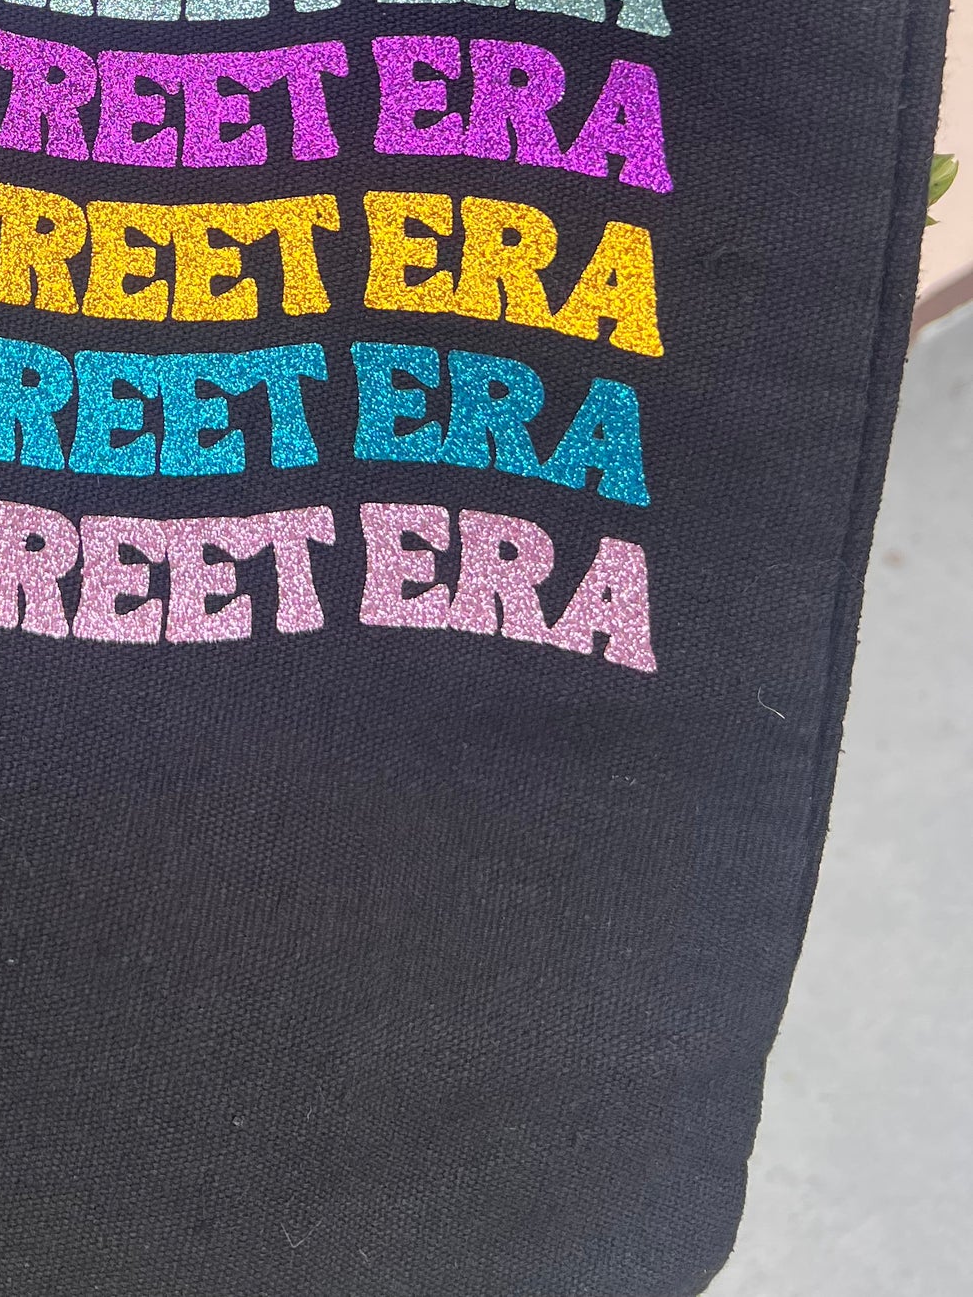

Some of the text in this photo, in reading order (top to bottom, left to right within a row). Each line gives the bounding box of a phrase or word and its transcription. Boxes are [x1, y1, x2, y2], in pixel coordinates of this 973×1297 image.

[372, 35, 674, 194] ERA
[363, 190, 665, 358] ERA
[350, 341, 651, 507] ERA
[359, 502, 658, 674] ERA
